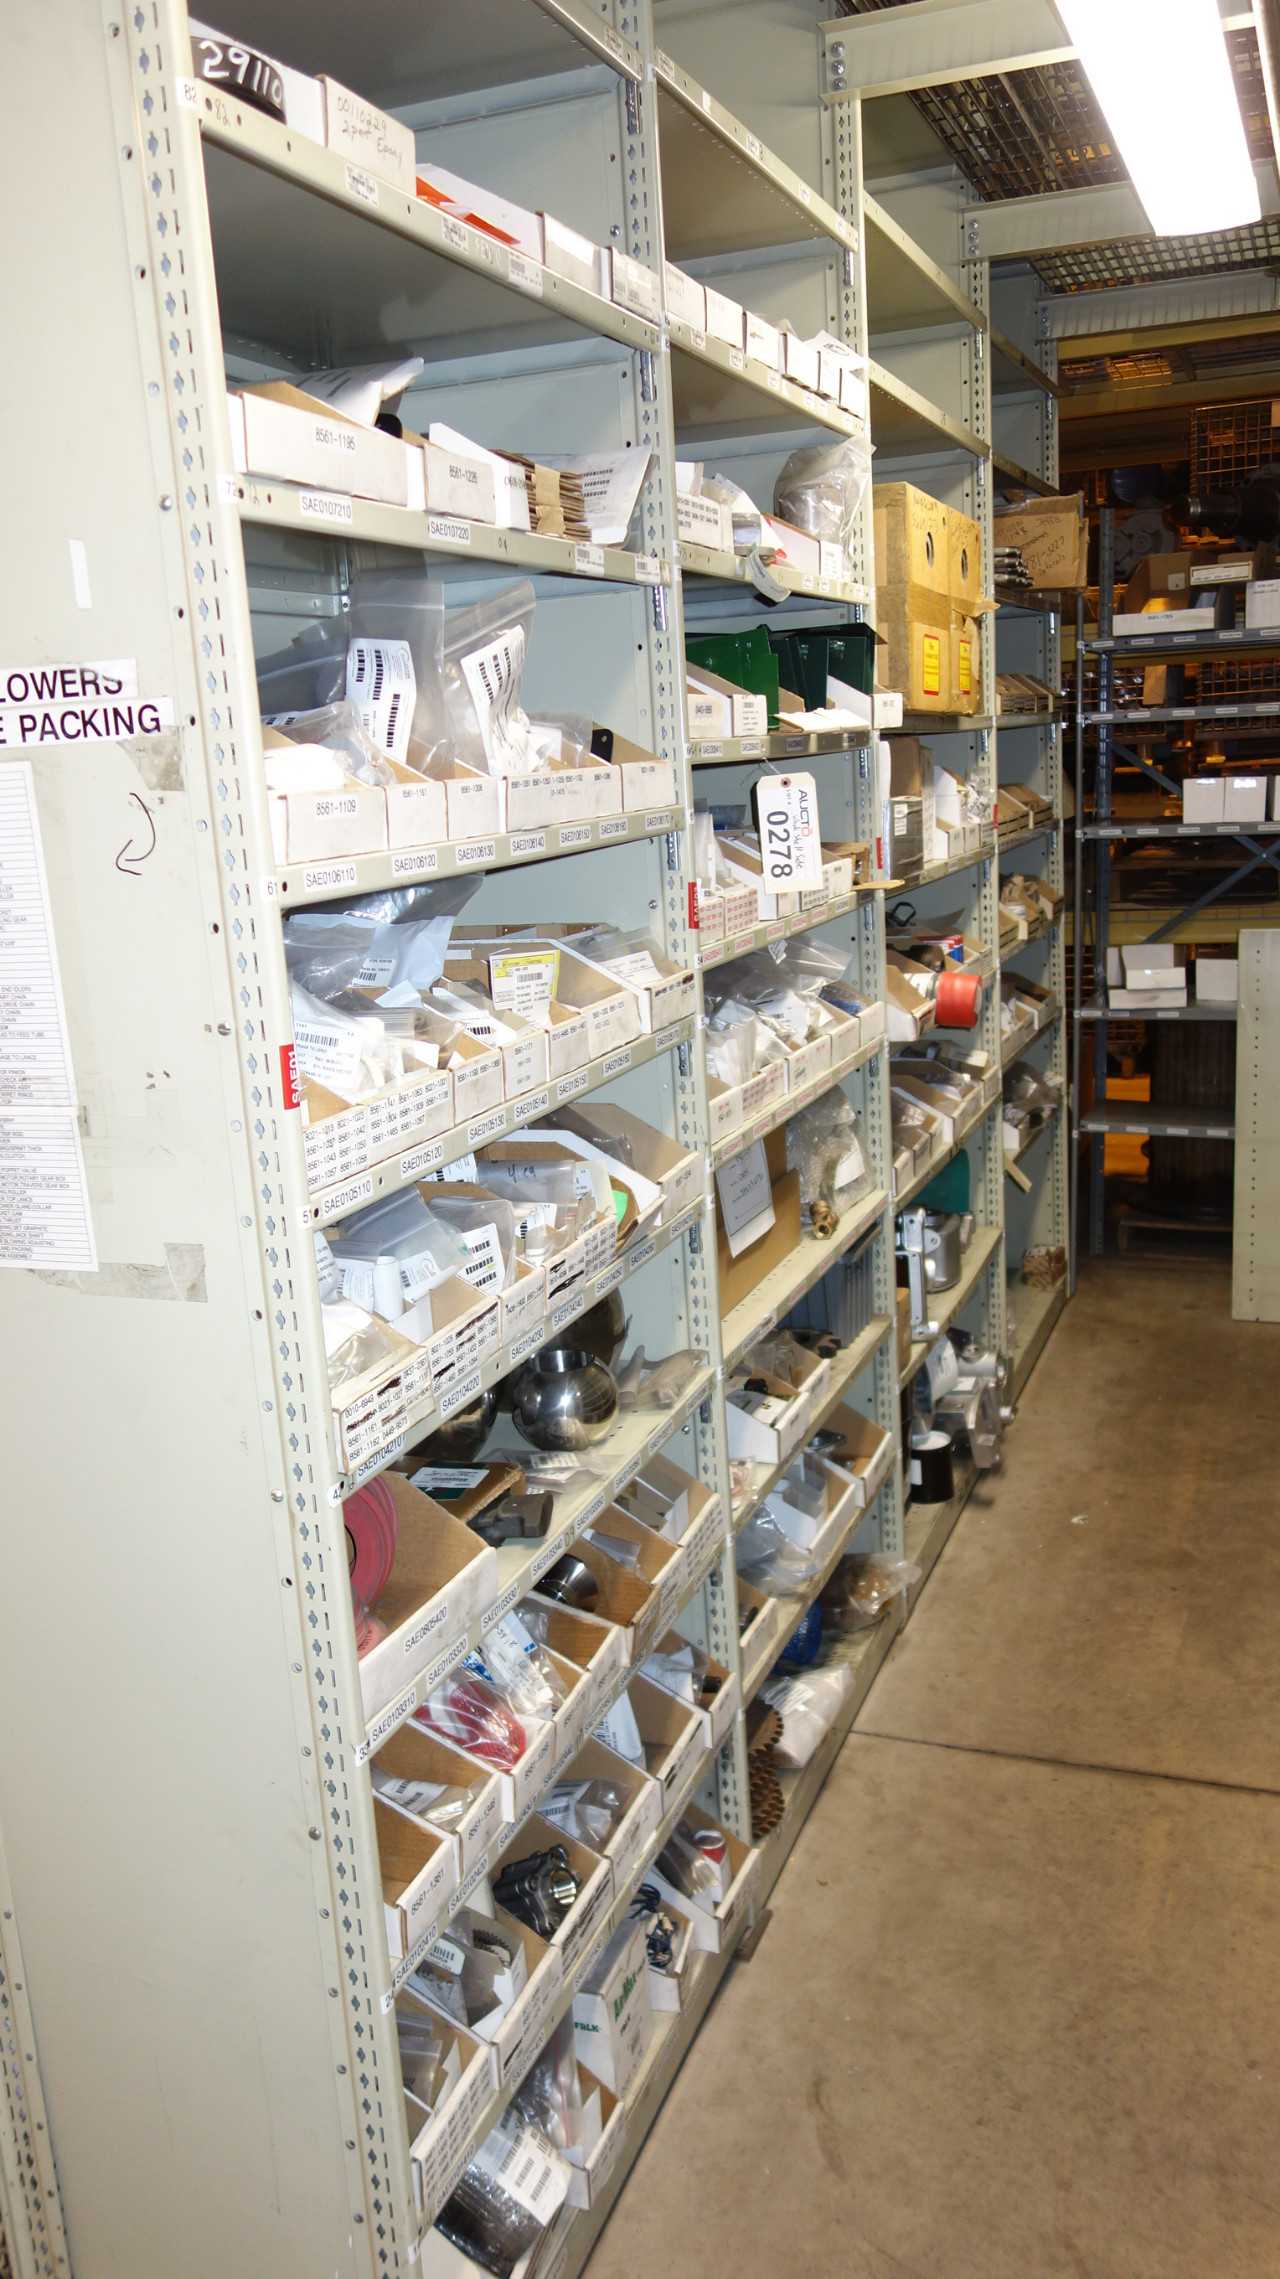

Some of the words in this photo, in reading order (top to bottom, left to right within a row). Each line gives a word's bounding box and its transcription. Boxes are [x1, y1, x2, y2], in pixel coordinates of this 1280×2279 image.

[199, 40, 283, 101] 29110
[302, 497, 352, 520] SAE0107210
[430, 520, 470, 542] SAE0107220
[19, 704, 161, 743] PACKING
[766, 811, 793, 879] 0278
[306, 867, 355, 887] SAE0106110
[394, 855, 436, 872] SAE0106120
[469, 1114, 505, 1140] SAE0105130
[402, 1146, 442, 1173] SAE0105120
[324, 1180, 372, 1213] SAE0105110
[405, 1606, 448, 1652] SAE0805420
[428, 1639, 467, 1685] SAE0103320
[372, 1692, 416, 1742] SAE0103310
